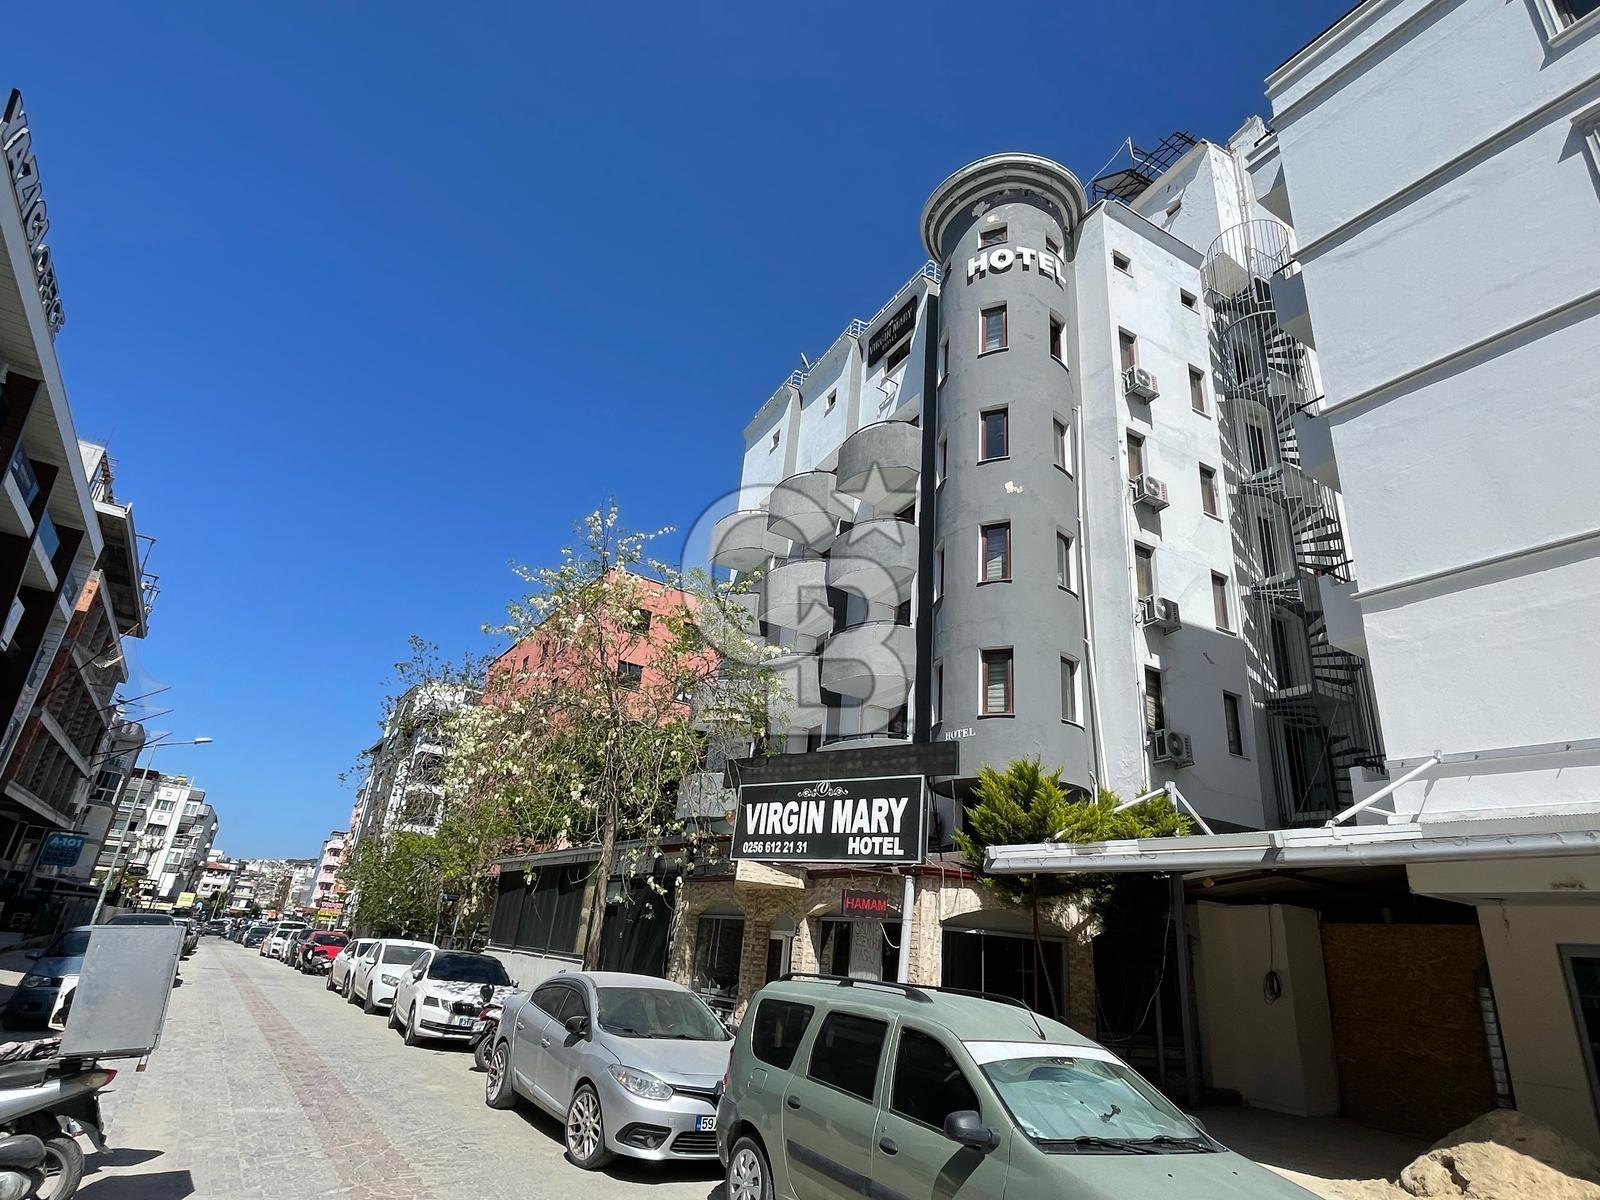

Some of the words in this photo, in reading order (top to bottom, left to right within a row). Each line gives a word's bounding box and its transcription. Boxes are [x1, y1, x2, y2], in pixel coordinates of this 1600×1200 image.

[967, 246, 1067, 285] HOTEL
[945, 727, 976, 741] HOTEL
[746, 800, 826, 835] VIRGIN
[831, 797, 909, 834] MARY
[50, 836, 82, 847] A-101
[742, 841, 763, 854] 0256
[765, 841, 781, 854] 612
[782, 841, 794, 854] 21
[796, 841, 808, 854] 31
[847, 836, 905, 856] HOTEL
[846, 897, 887, 911] HAMAM
